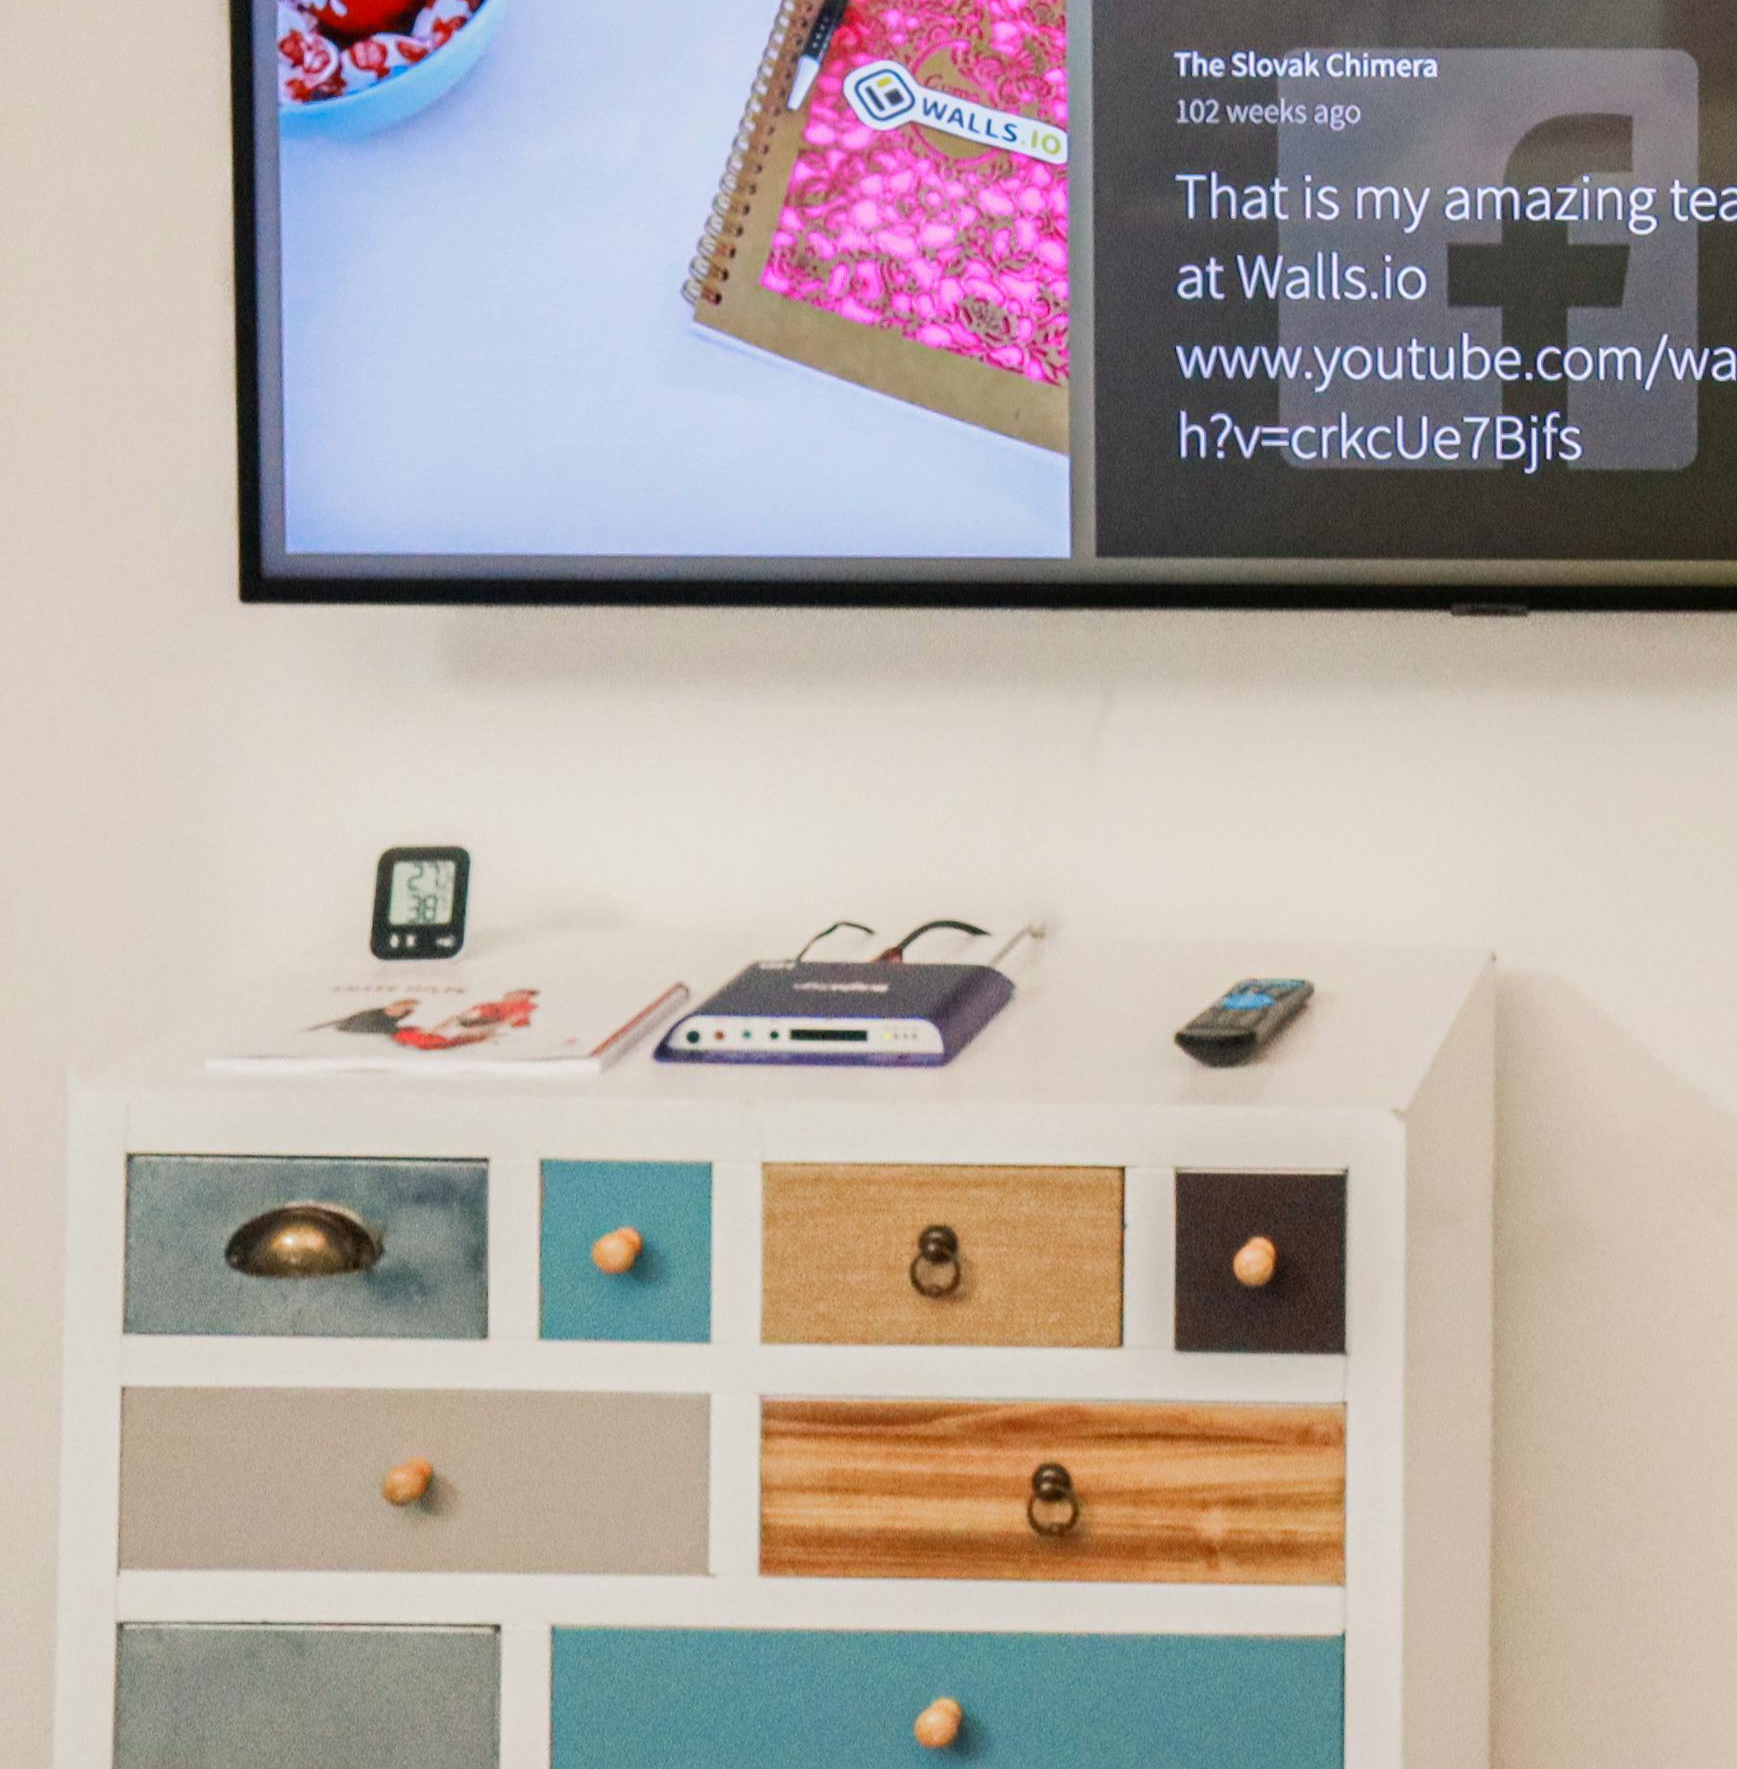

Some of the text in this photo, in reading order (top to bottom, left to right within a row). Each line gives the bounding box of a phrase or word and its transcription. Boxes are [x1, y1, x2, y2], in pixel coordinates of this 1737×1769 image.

[1173, 50, 1440, 79] The Slovak Chimera
[922, 96, 1062, 156] WALLS.IO
[1175, 96, 1362, 132] 102 weeks ago
[1174, 172, 1291, 222] That
[1305, 174, 1341, 222] is
[1356, 186, 1432, 234] my
[1444, 174, 1659, 236] amazing
[1176, 252, 1429, 301] at Walls.io
[1179, 410, 1585, 476] h?v=crkcUe7Bjfs
